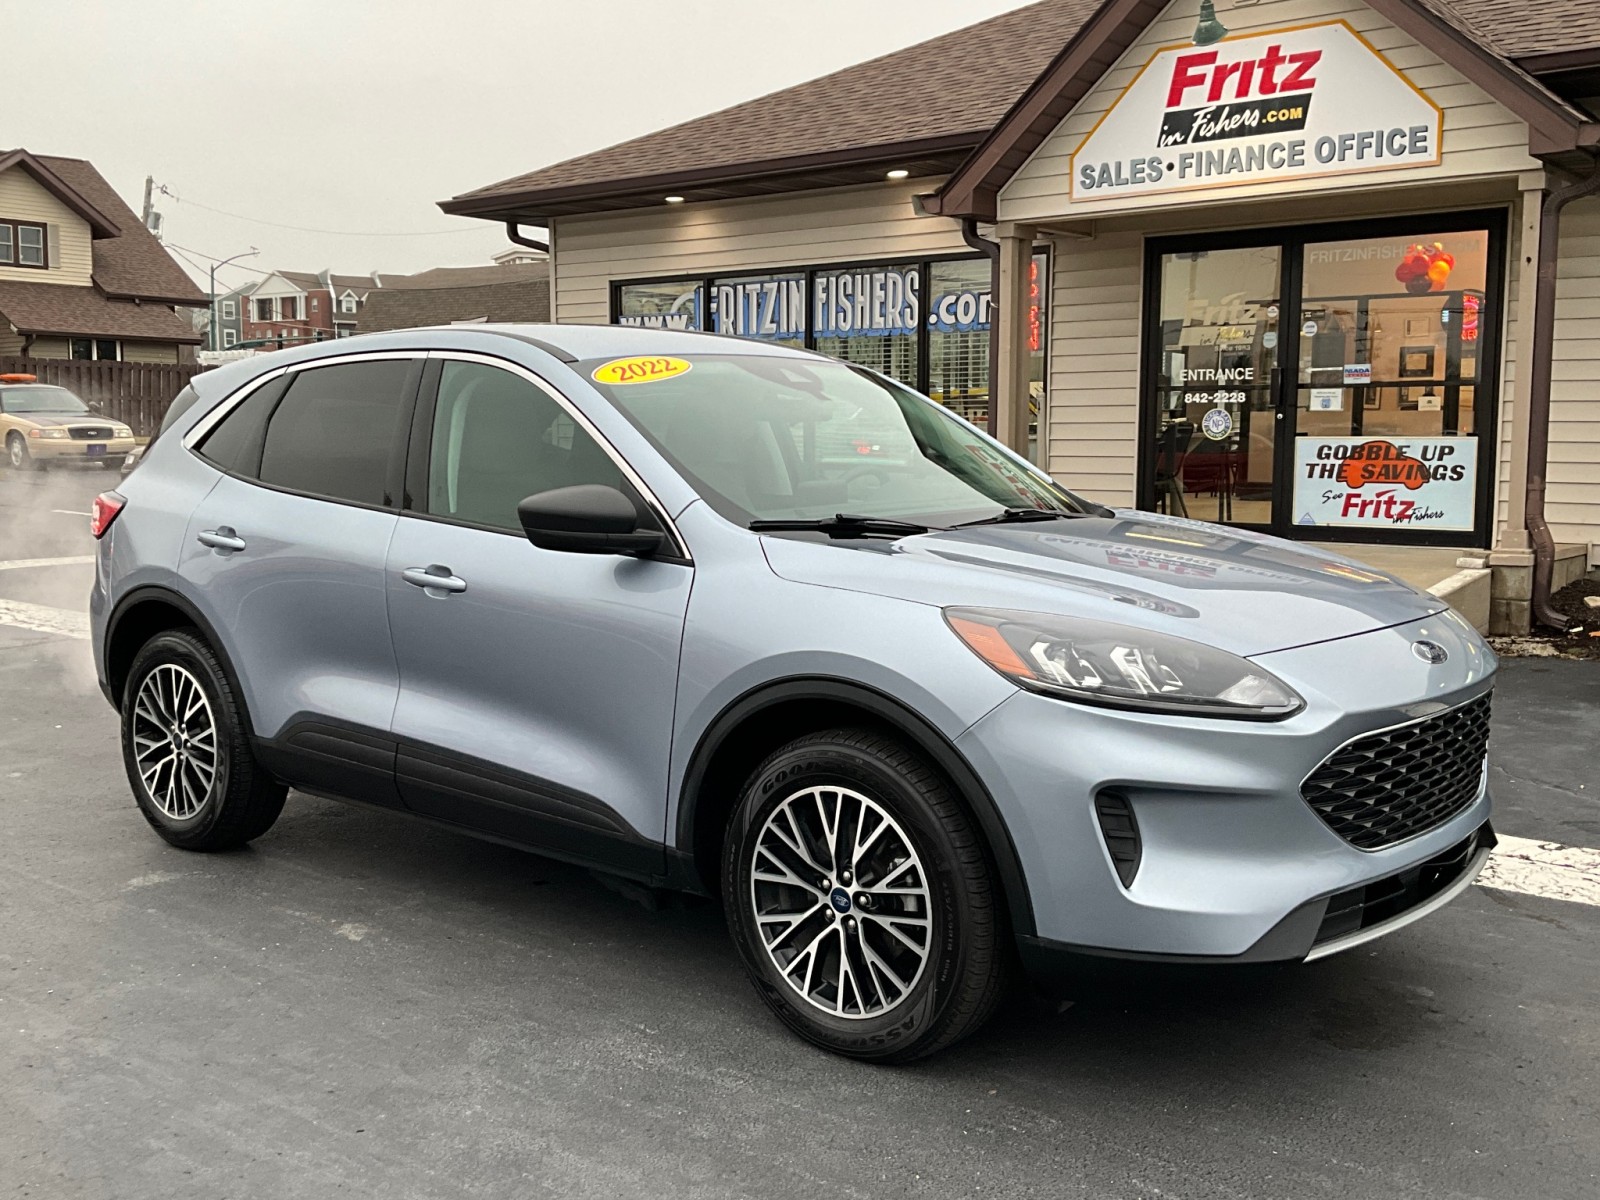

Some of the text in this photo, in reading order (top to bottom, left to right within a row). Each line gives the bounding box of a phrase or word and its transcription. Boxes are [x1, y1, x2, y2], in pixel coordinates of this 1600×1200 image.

[1166, 45, 1322, 108] Fritz
[1160, 125, 1185, 147] in
[1178, 139, 1305, 179] FINANCE
[1314, 125, 1428, 164] OFFICE
[611, 358, 678, 382] 2022
[1179, 367, 1254, 381] ENTRANCE
[1184, 392, 1246, 404] 842-2228
[1316, 444, 1455, 462] GOBBLE UP
[1306, 463, 1466, 481] THE SAVINGS
[1322, 490, 1344, 504] See
[1341, 489, 1415, 520] Fritz
[1407, 505, 1445, 525] Fishers
